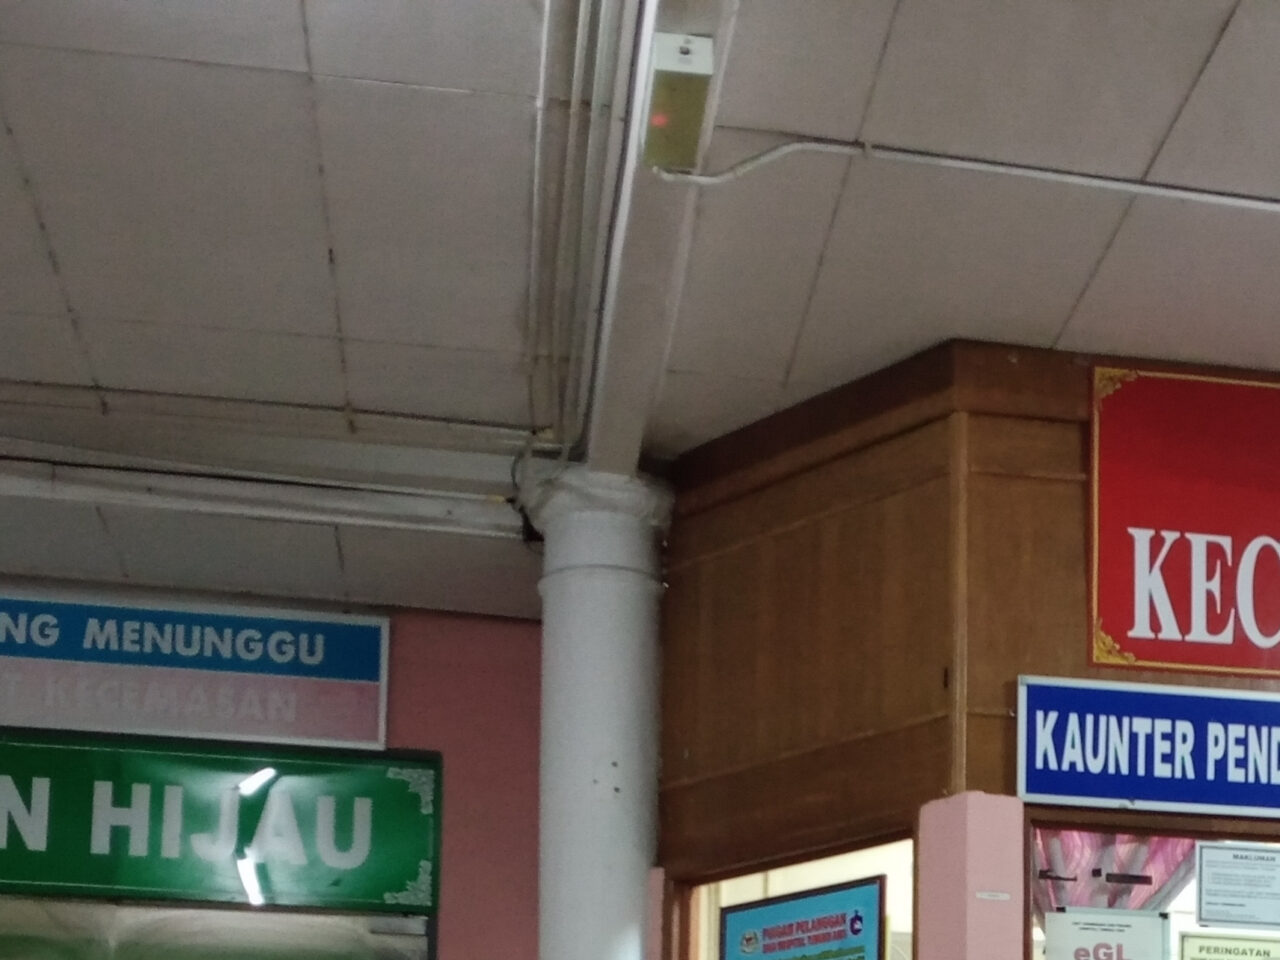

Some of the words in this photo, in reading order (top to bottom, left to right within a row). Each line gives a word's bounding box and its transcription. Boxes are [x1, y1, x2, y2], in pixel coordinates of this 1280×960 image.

[83, 617, 326, 666] MENUNGGU
[1036, 710, 1196, 782] KAUNTER
[90, 779, 373, 870] HIJAU
[1198, 945, 1271, 957] PERINGATAN
